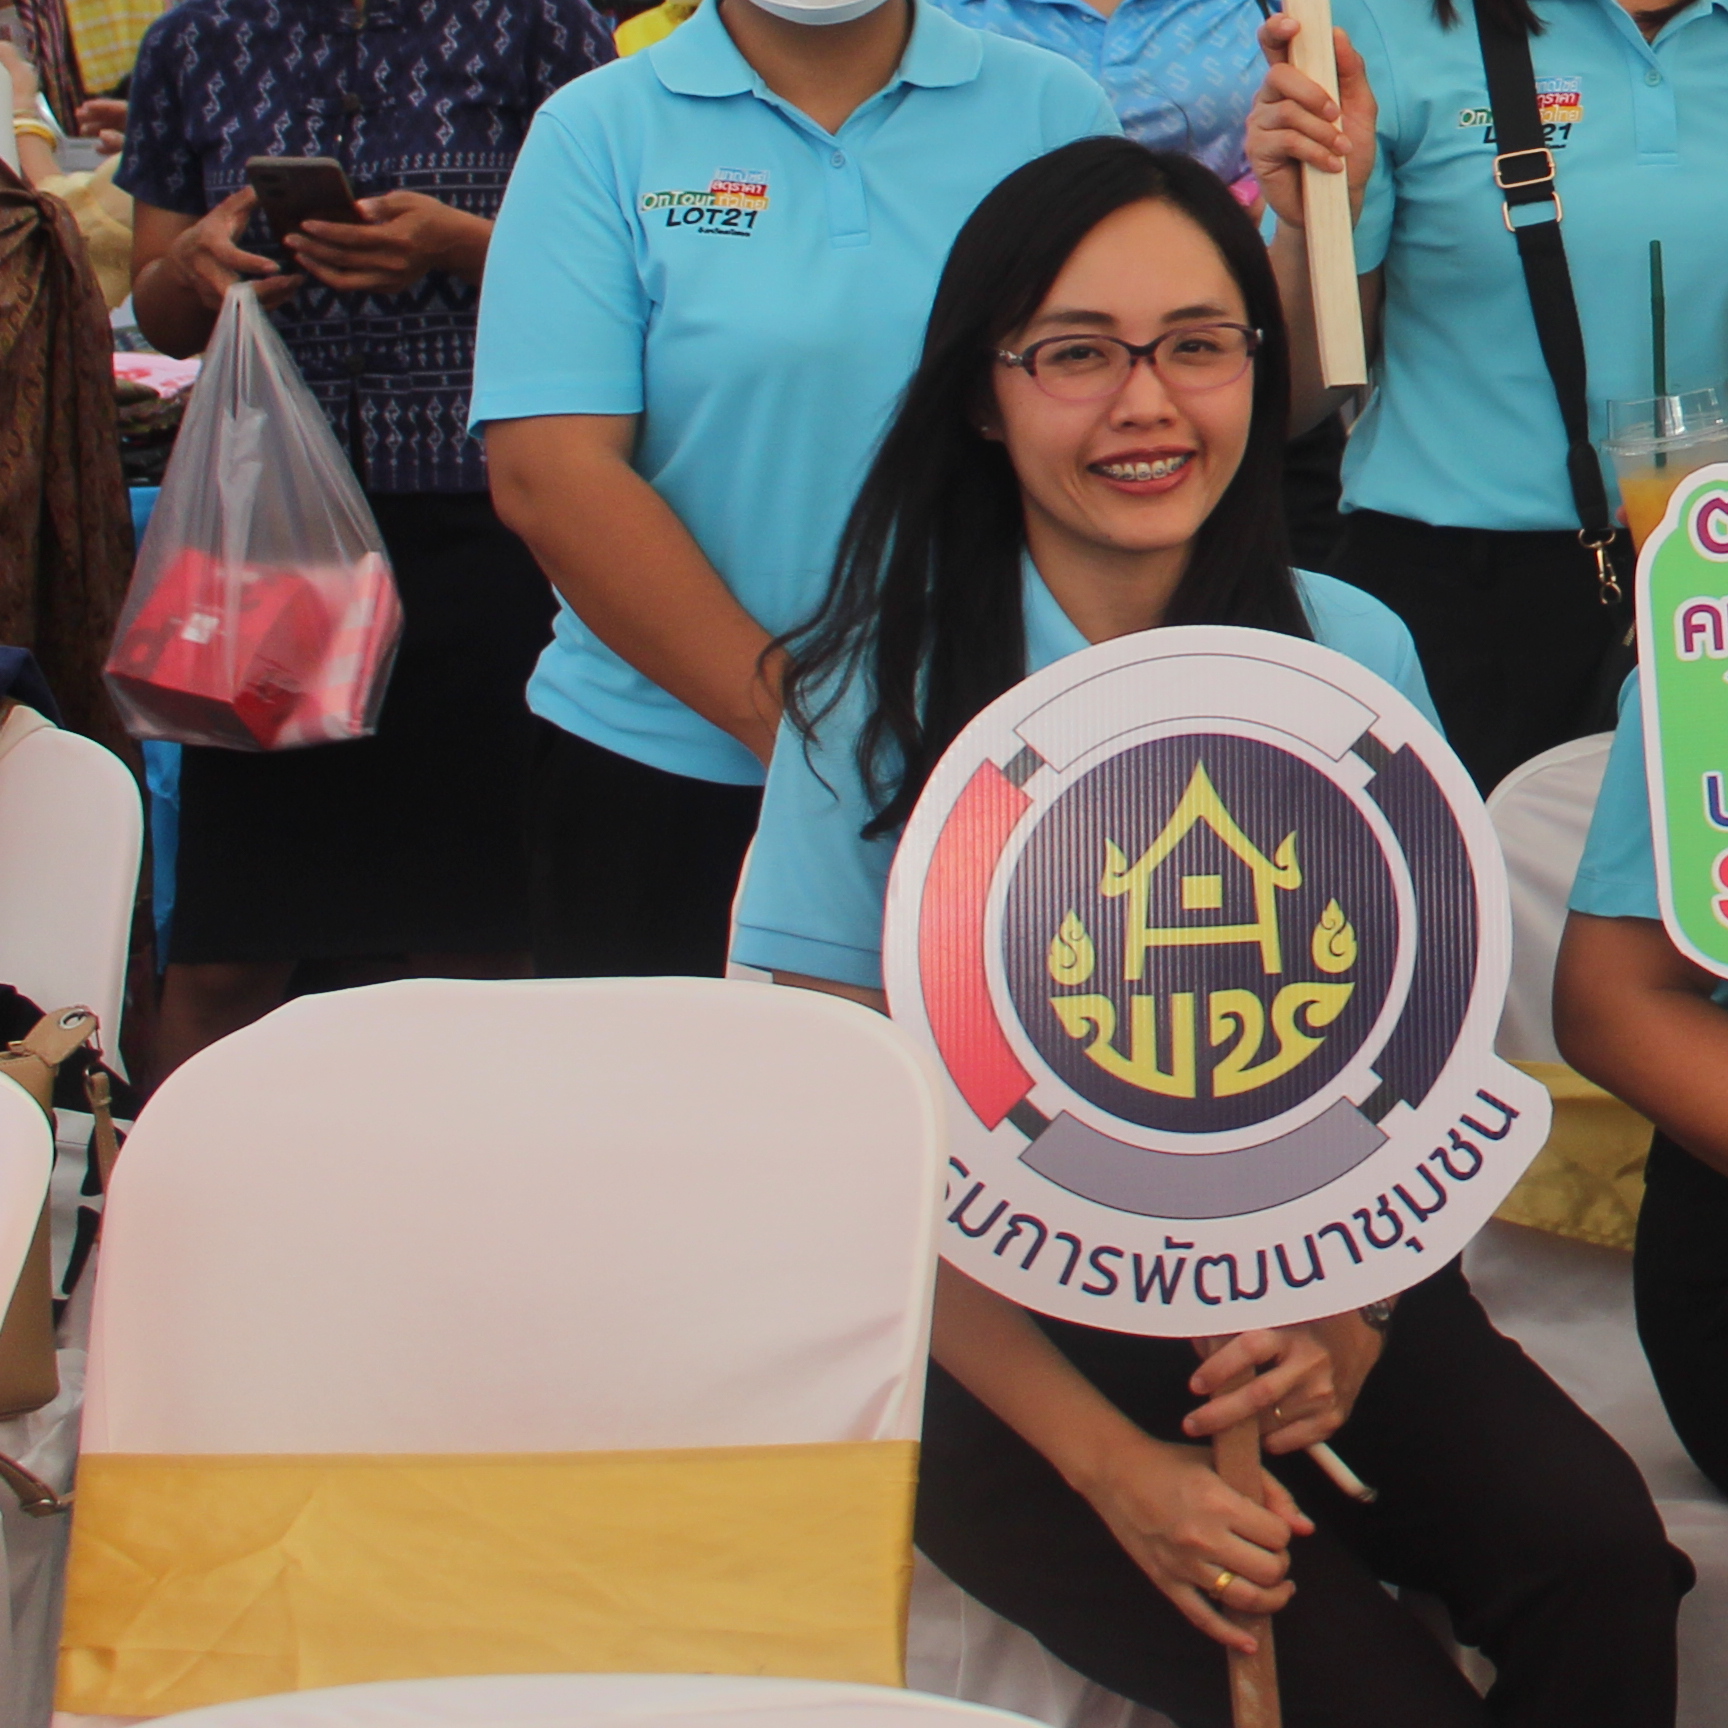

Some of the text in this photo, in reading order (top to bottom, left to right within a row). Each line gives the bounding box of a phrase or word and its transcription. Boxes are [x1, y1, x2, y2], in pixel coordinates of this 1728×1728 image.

[1484, 122, 1572, 144] L21
[666, 207, 758, 229] LOT21
[945, 1087, 1520, 1306] มการพัฒนาชุมชน
